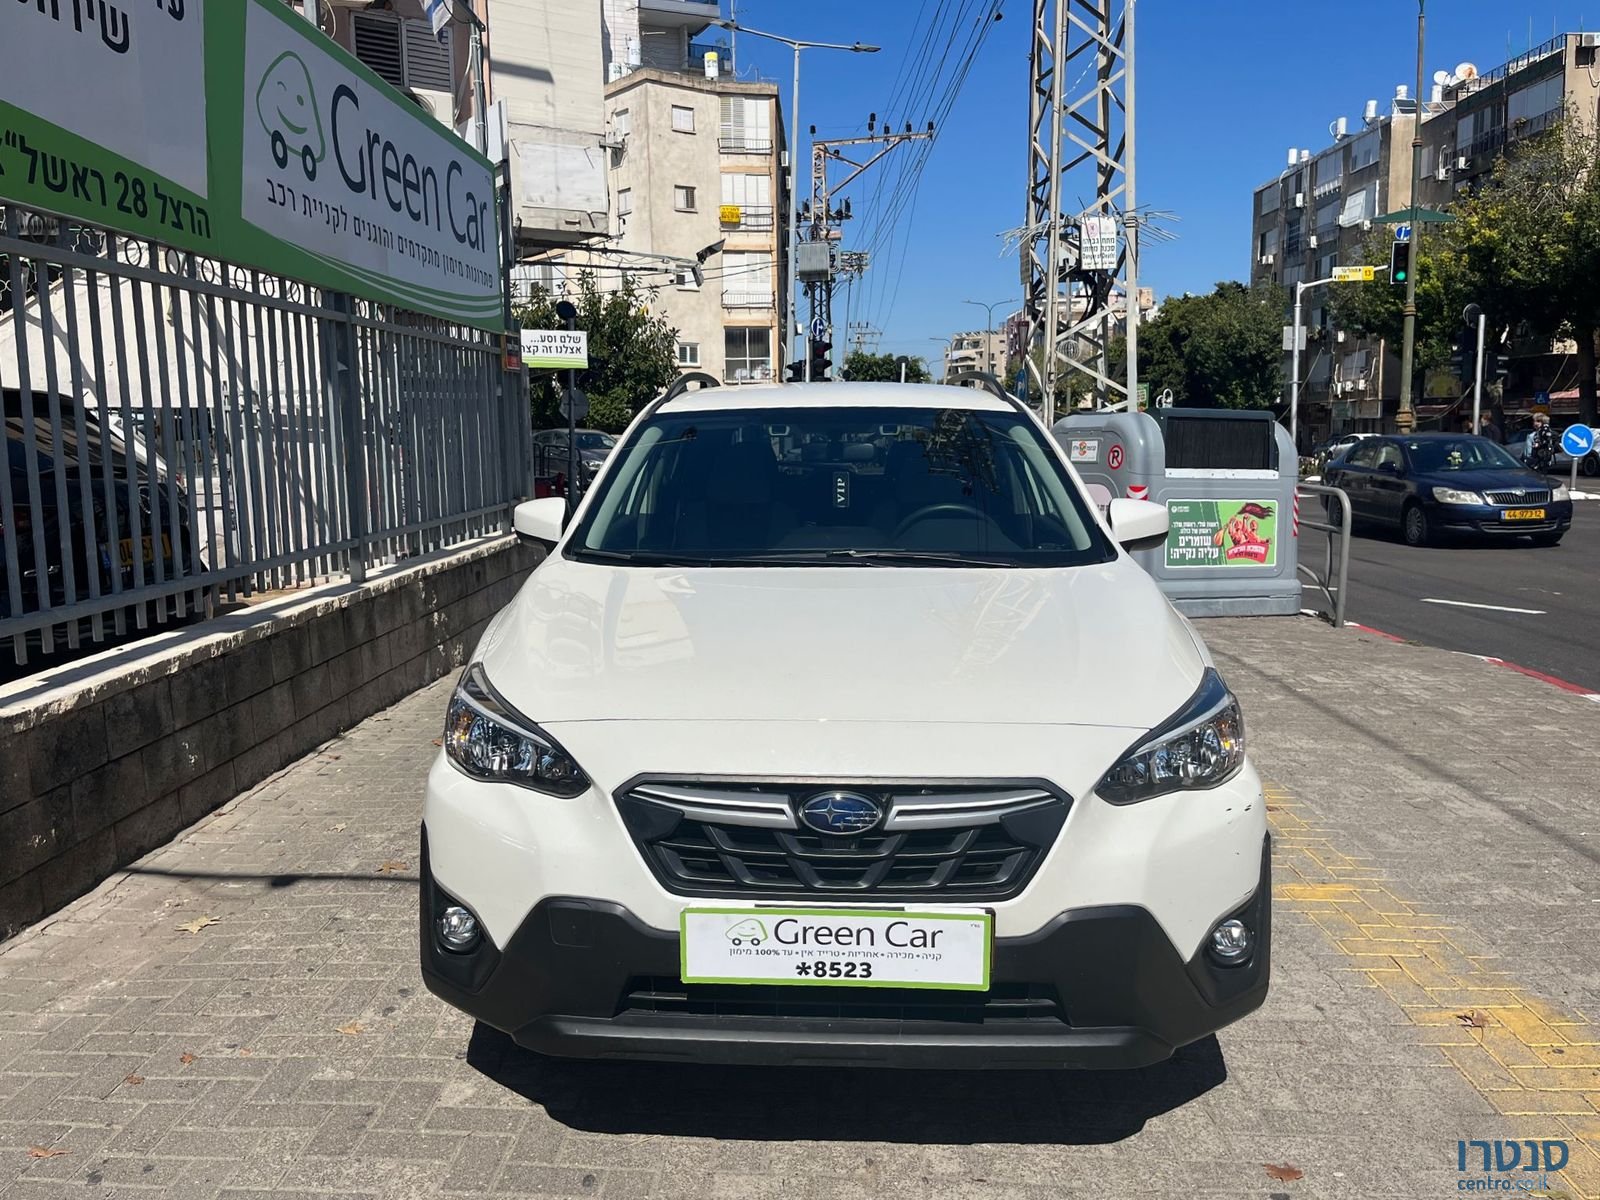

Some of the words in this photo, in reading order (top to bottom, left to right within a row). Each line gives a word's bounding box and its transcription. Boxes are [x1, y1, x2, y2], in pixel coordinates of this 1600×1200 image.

[0, 129, 107, 207] ראשל"
[331, 83, 442, 232] Green
[446, 159, 488, 253] Car
[113, 171, 148, 219] 28
[266, 178, 298, 213] רכב
[152, 182, 211, 239] הרצל
[302, 192, 348, 234] לקניית
[352, 216, 394, 250] והוגנים
[397, 235, 440, 268] מתקדמים
[442, 253, 464, 276] מימון
[465, 263, 493, 288] פתרונות
[560, 334, 581, 344] שלם
[542, 345, 552, 354] זה
[555, 344, 582, 354] אצלנו
[837, 478, 845, 503] VIP
[1178, 535, 1212, 547] שומרים
[1170, 547, 1196, 561] נקייה!
[1198, 546, 1219, 559] עליה
[774, 918, 875, 947] Green
[885, 921, 944, 949] Car
[729, 948, 753, 957] מימון
[781, 949, 793, 957] עד
[801, 949, 814, 959] אין
[817, 950, 840, 958] טרייד
[847, 951, 880, 959] אחריות
[887, 951, 915, 960] מכירה
[921, 952, 942, 962] קניה
